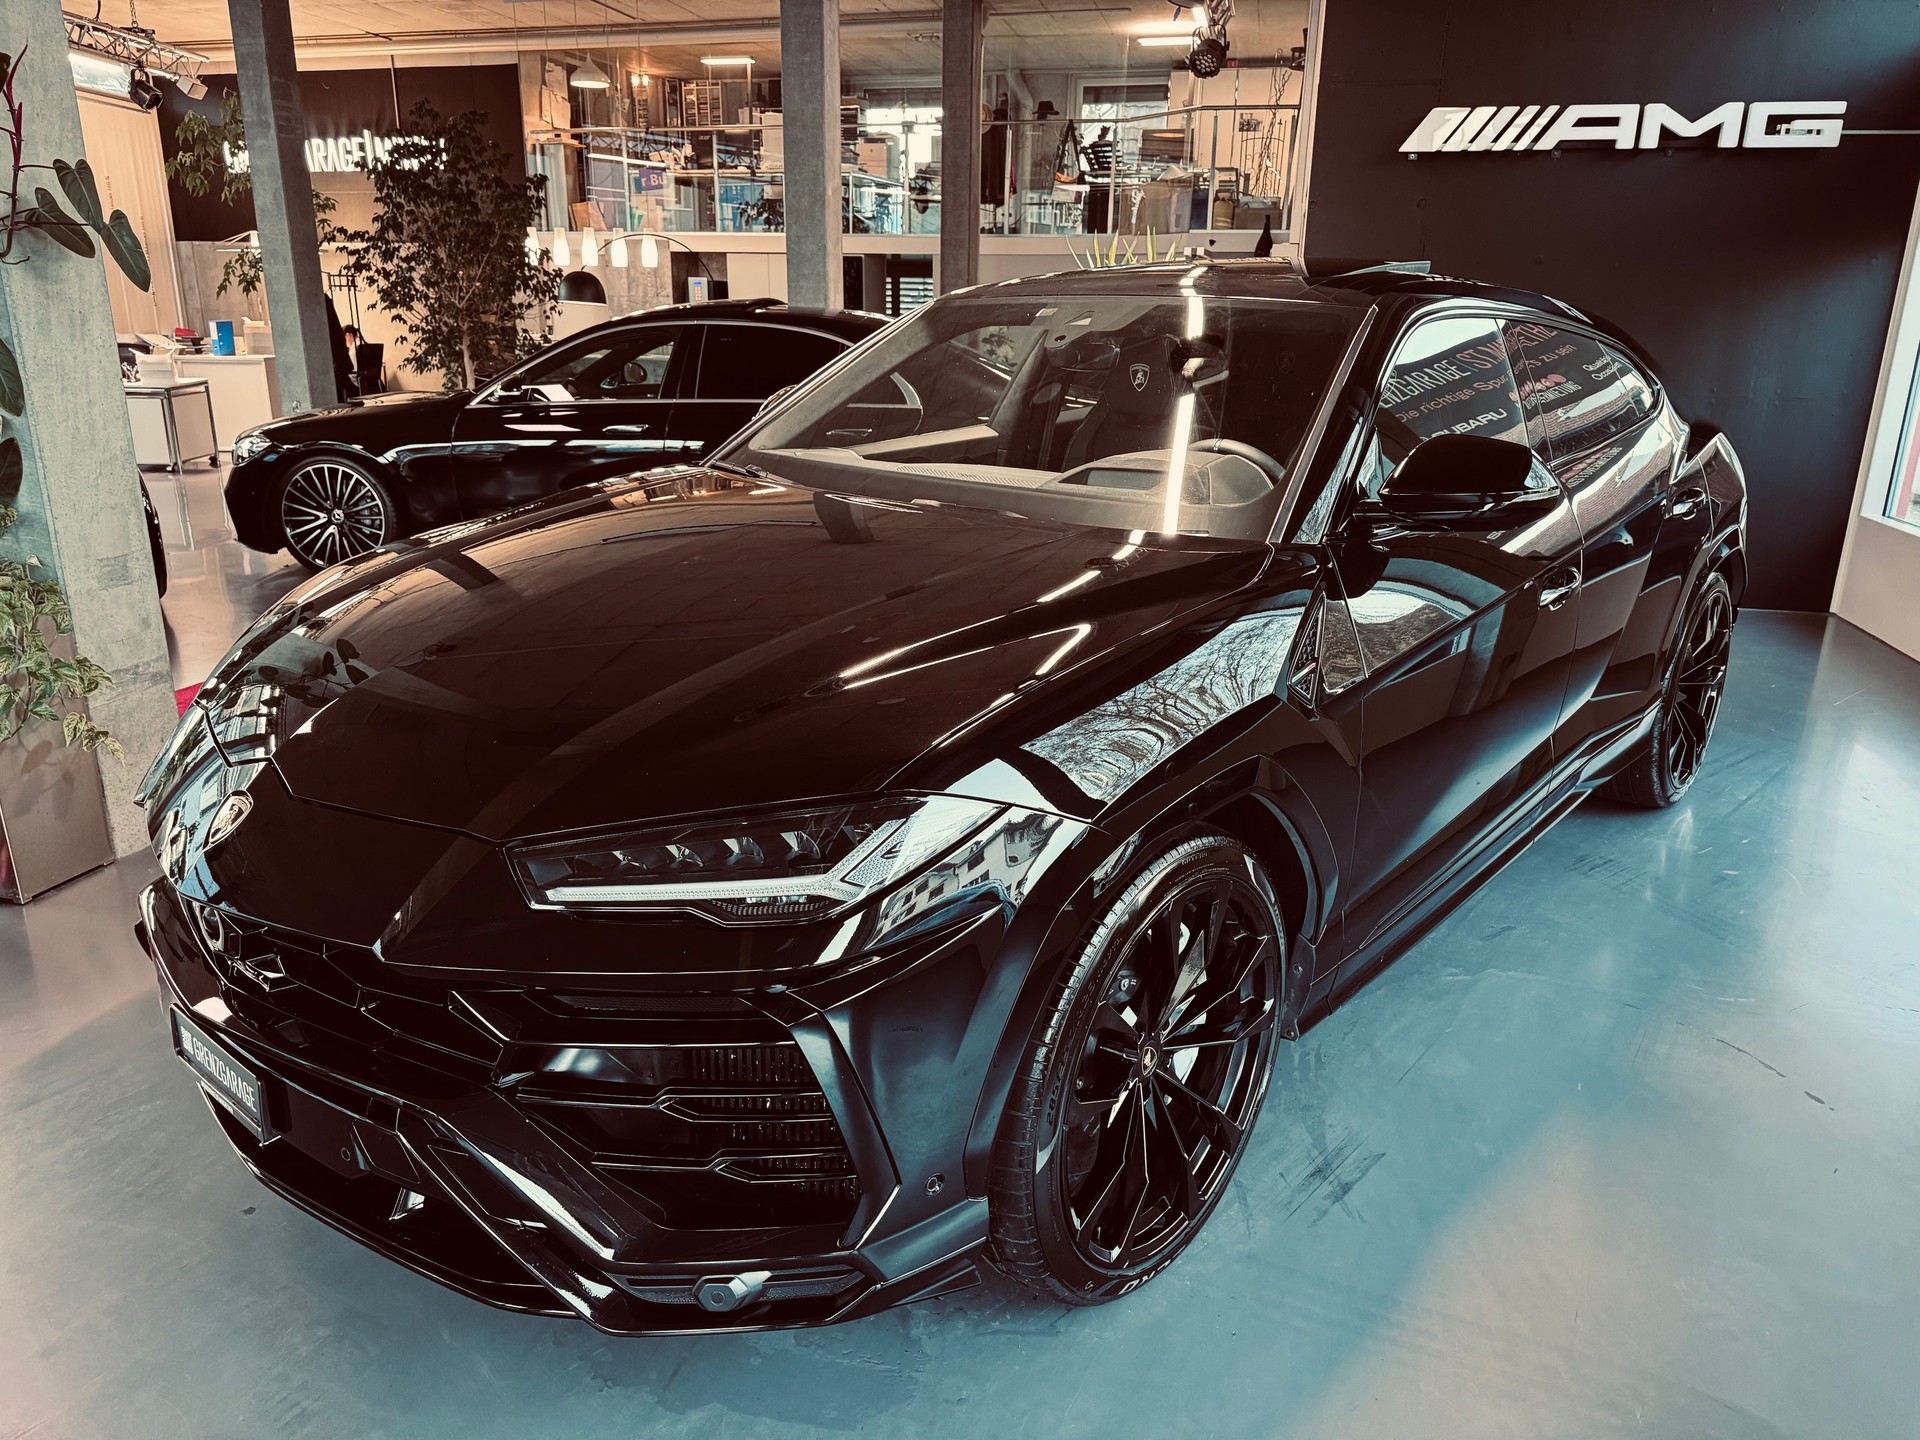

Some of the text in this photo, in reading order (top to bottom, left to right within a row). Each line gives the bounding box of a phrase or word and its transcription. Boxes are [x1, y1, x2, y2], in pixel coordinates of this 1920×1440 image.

[1531, 100, 1848, 150] AMG
[1419, 387, 1476, 413] richtige
[193, 1036, 257, 1113] GRENZGARAGE
